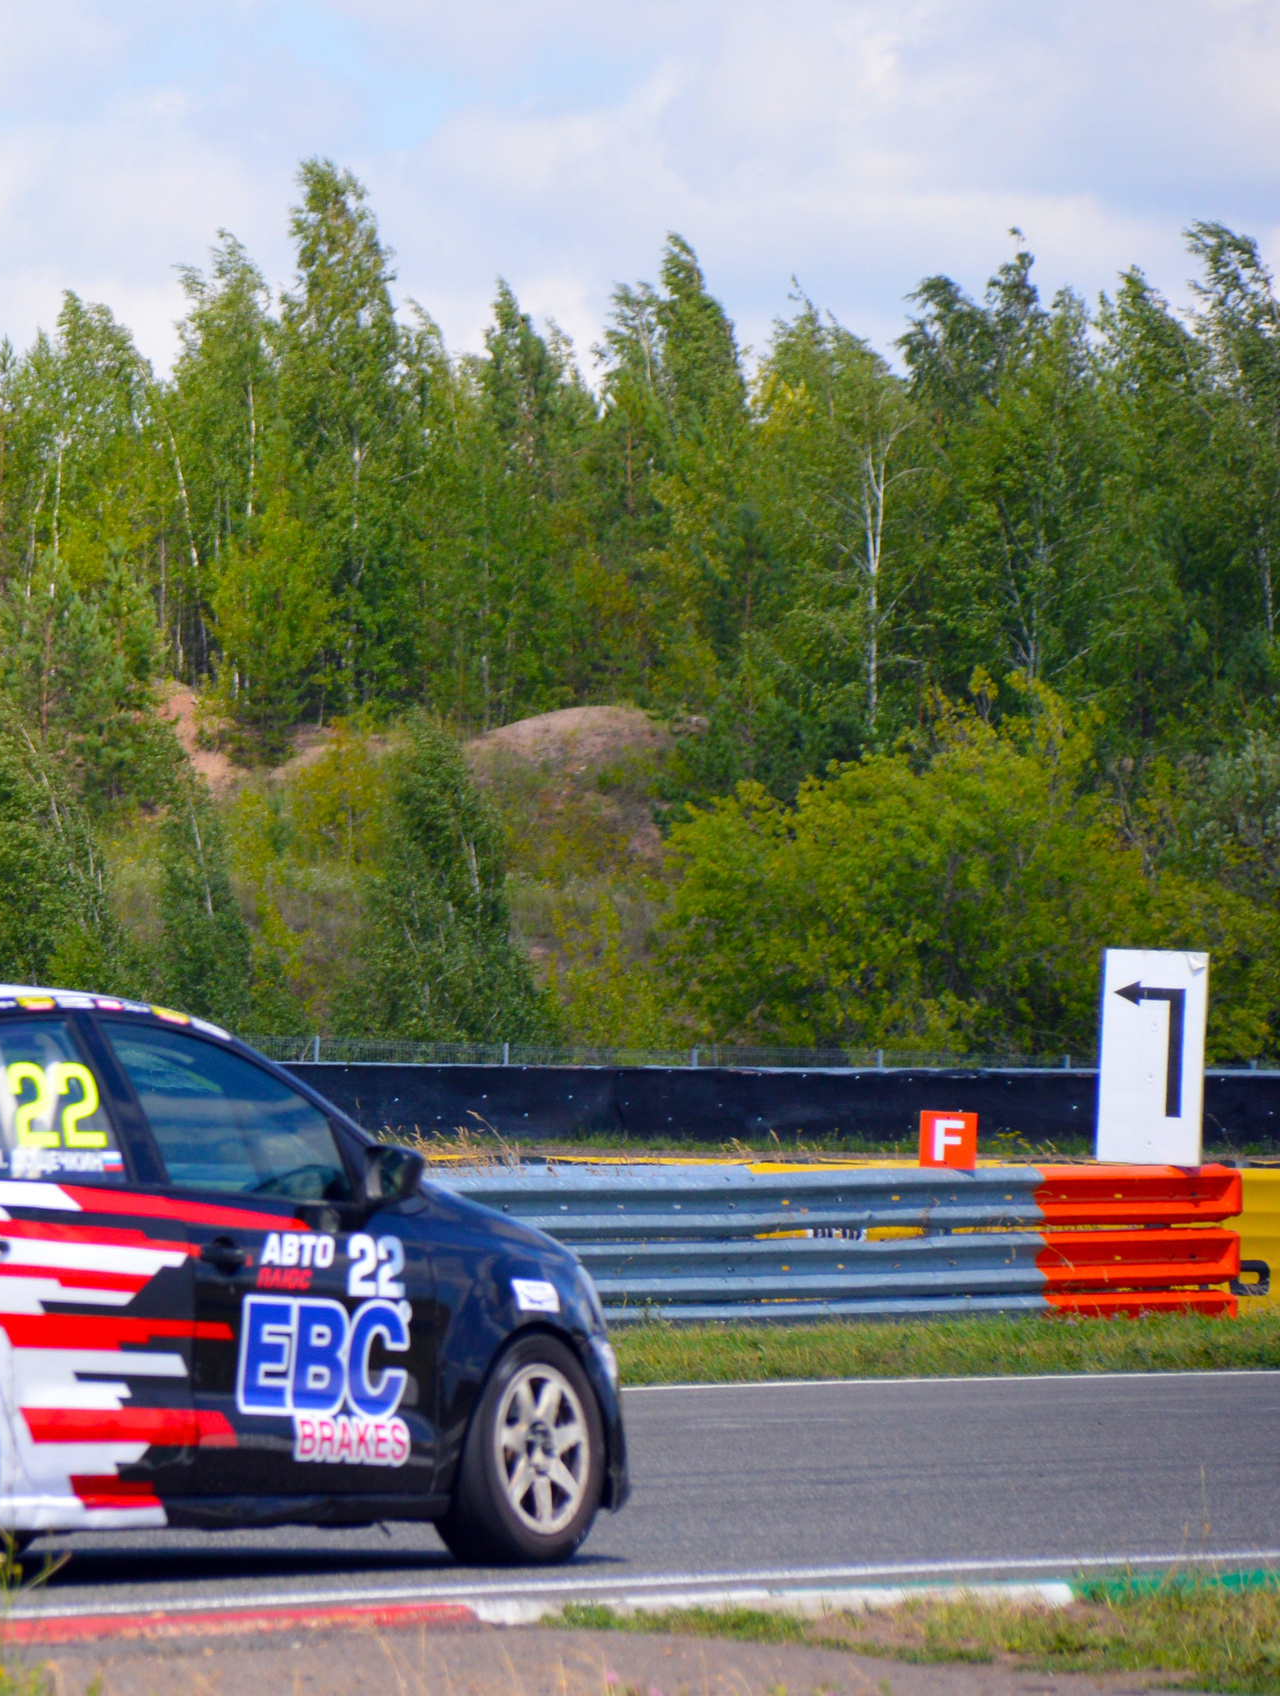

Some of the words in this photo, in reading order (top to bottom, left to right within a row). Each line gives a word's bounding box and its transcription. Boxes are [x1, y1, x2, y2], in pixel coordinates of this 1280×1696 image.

[7, 1061, 108, 1148] 22
[933, 1119, 966, 1161] F
[347, 1233, 407, 1298] 22
[238, 1295, 411, 1420] EBC
[296, 1417, 409, 1463] BRAKES
